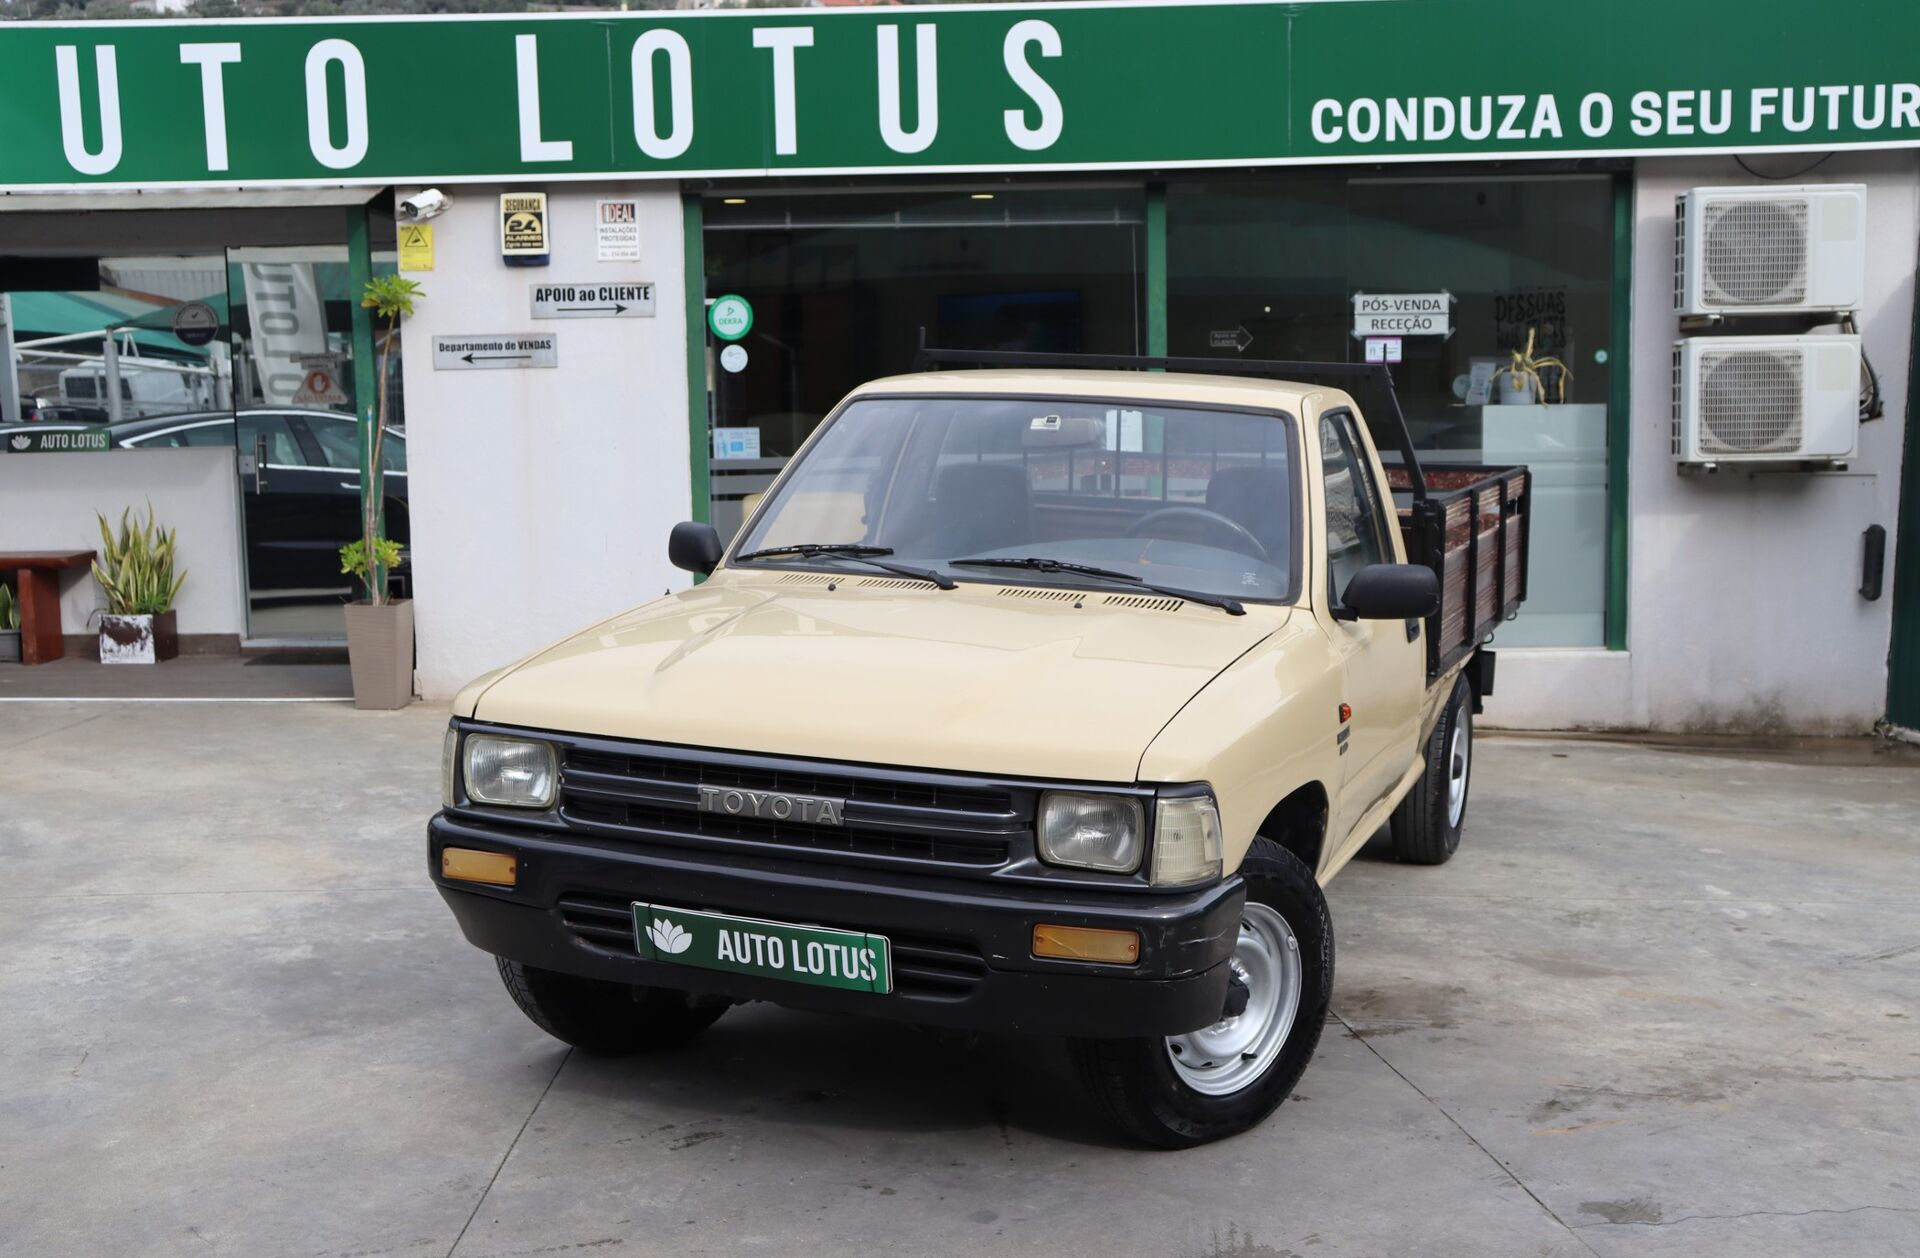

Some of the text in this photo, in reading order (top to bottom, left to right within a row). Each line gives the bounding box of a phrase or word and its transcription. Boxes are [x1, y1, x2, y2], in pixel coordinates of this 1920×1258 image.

[515, 19, 1064, 163] LOTUS
[1310, 83, 1920, 144] CONDUZA O SEU FUTUR
[602, 204, 635, 223] IDEAL
[508, 220, 537, 233] 24
[535, 285, 651, 303] APOIO ao CLIENTE
[1361, 296, 1442, 312] PÓS-VENDA
[718, 317, 744, 326] DEKRA
[1371, 315, 1433, 333] RECEÇÃO
[438, 339, 552, 353] Departamento de VENDAS
[40, 433, 106, 449] AUTO LOTUS
[701, 788, 840, 825] TOYOTA
[717, 928, 878, 982] AUTO LOTUS
